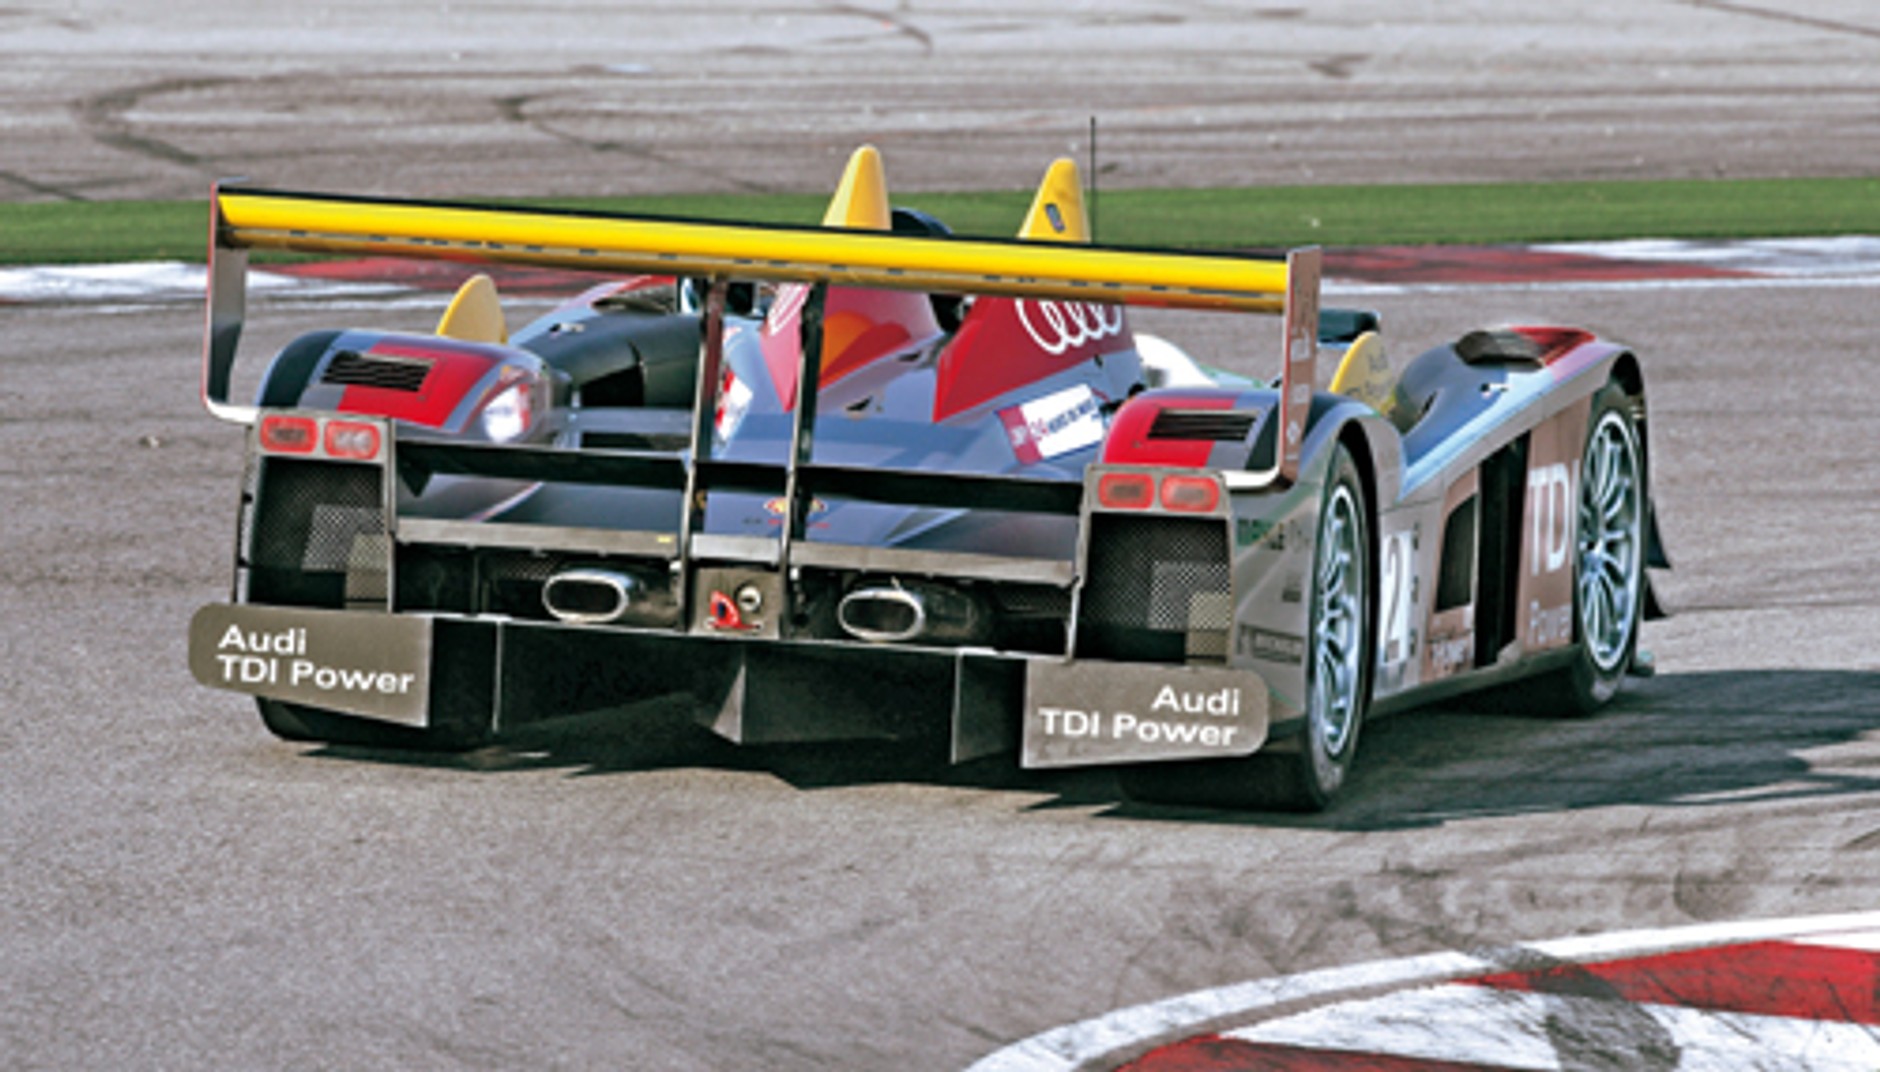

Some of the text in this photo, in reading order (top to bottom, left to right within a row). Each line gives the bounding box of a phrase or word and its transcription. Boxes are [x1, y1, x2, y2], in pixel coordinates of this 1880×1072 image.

[1528, 458, 1580, 577] TDI
[217, 624, 307, 656] Audi
[216, 653, 415, 694] TDI Power
[1151, 684, 1242, 716] Audi
[1038, 707, 1238, 746] TDI Power
